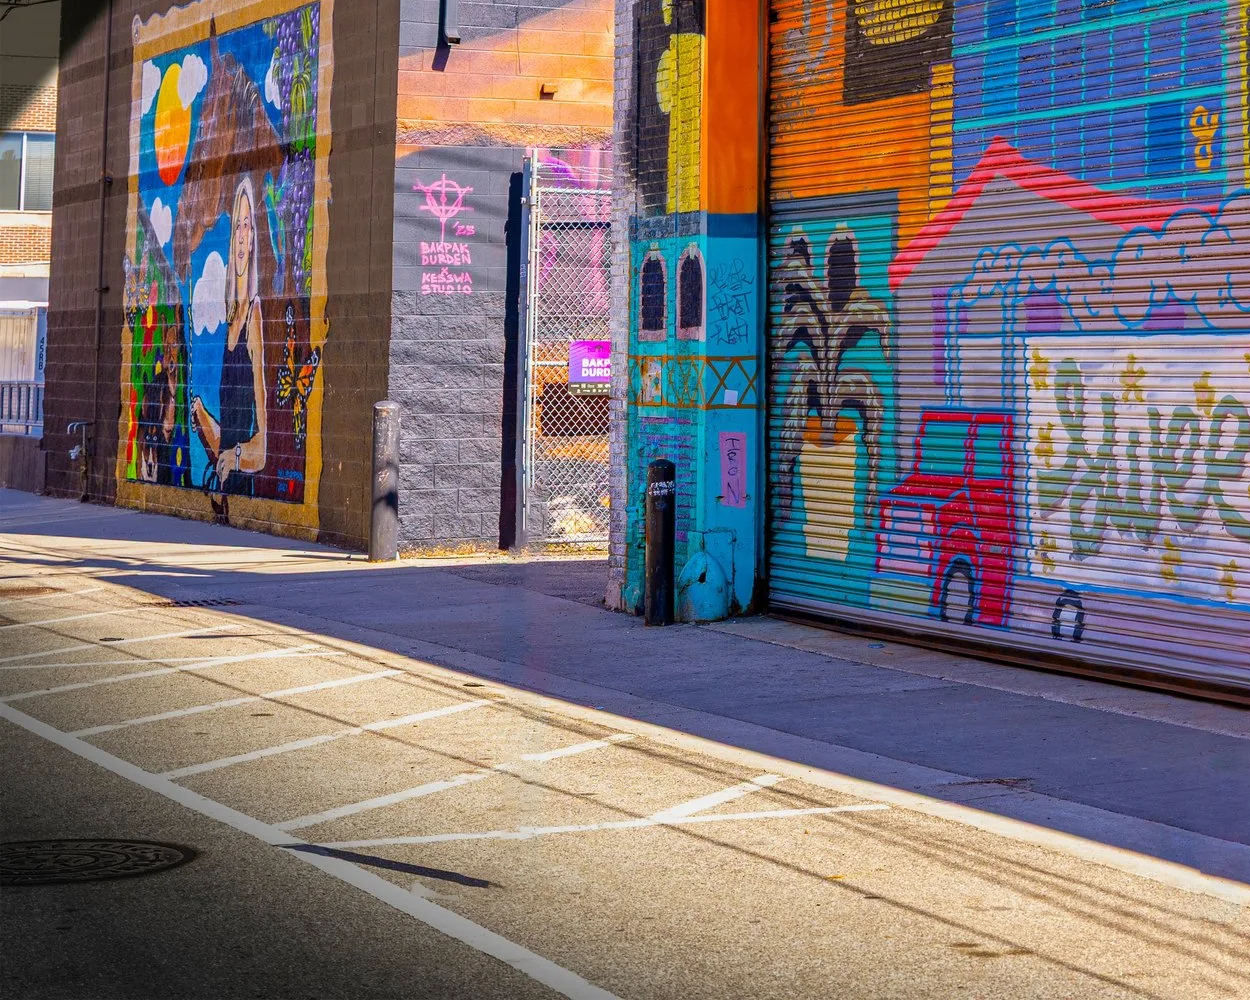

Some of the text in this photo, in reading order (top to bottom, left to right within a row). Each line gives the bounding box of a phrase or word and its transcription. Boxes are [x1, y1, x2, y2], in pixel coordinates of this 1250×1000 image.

[420, 242, 470, 254] BAKPAK
[421, 254, 471, 266] DURDEN
[421, 285, 472, 295] STUDIO
